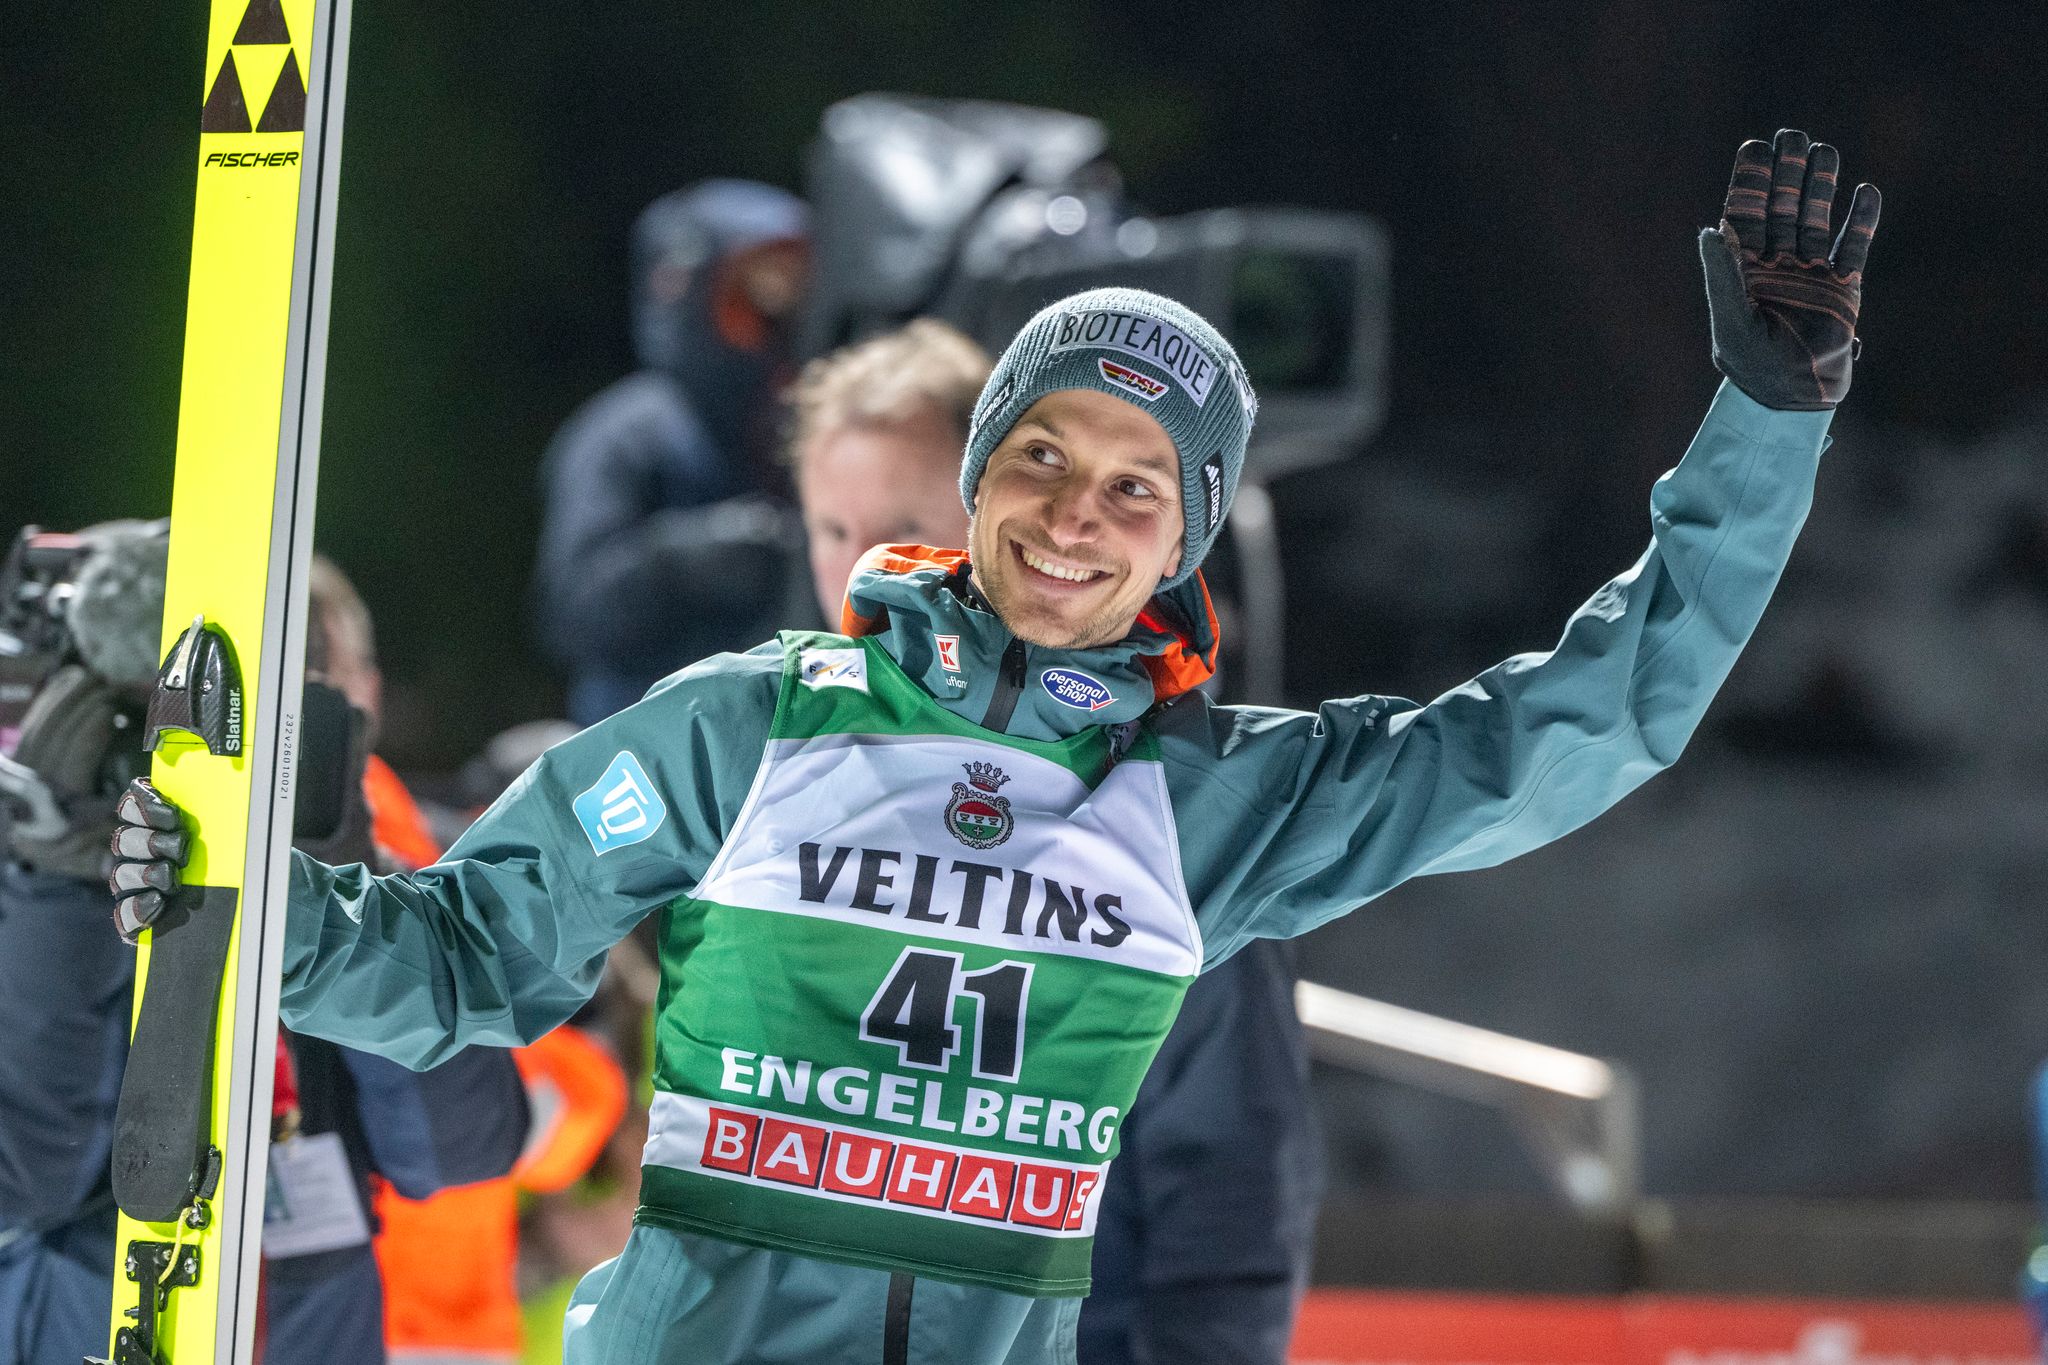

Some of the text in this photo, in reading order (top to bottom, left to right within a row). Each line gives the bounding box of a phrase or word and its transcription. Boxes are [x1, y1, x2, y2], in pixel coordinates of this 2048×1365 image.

[205, 151, 300, 168] FISCHER
[1059, 311, 1210, 396] BIOTEAQUE
[1124, 371, 1165, 396] DSV
[1046, 671, 1106, 700] personal
[1055, 684, 1088, 703] shop
[225, 688, 241, 751] Slatnar
[798, 841, 1133, 948] VELTINS
[860, 946, 1035, 1083] 41
[720, 1046, 1120, 1154] ENGELBERG
